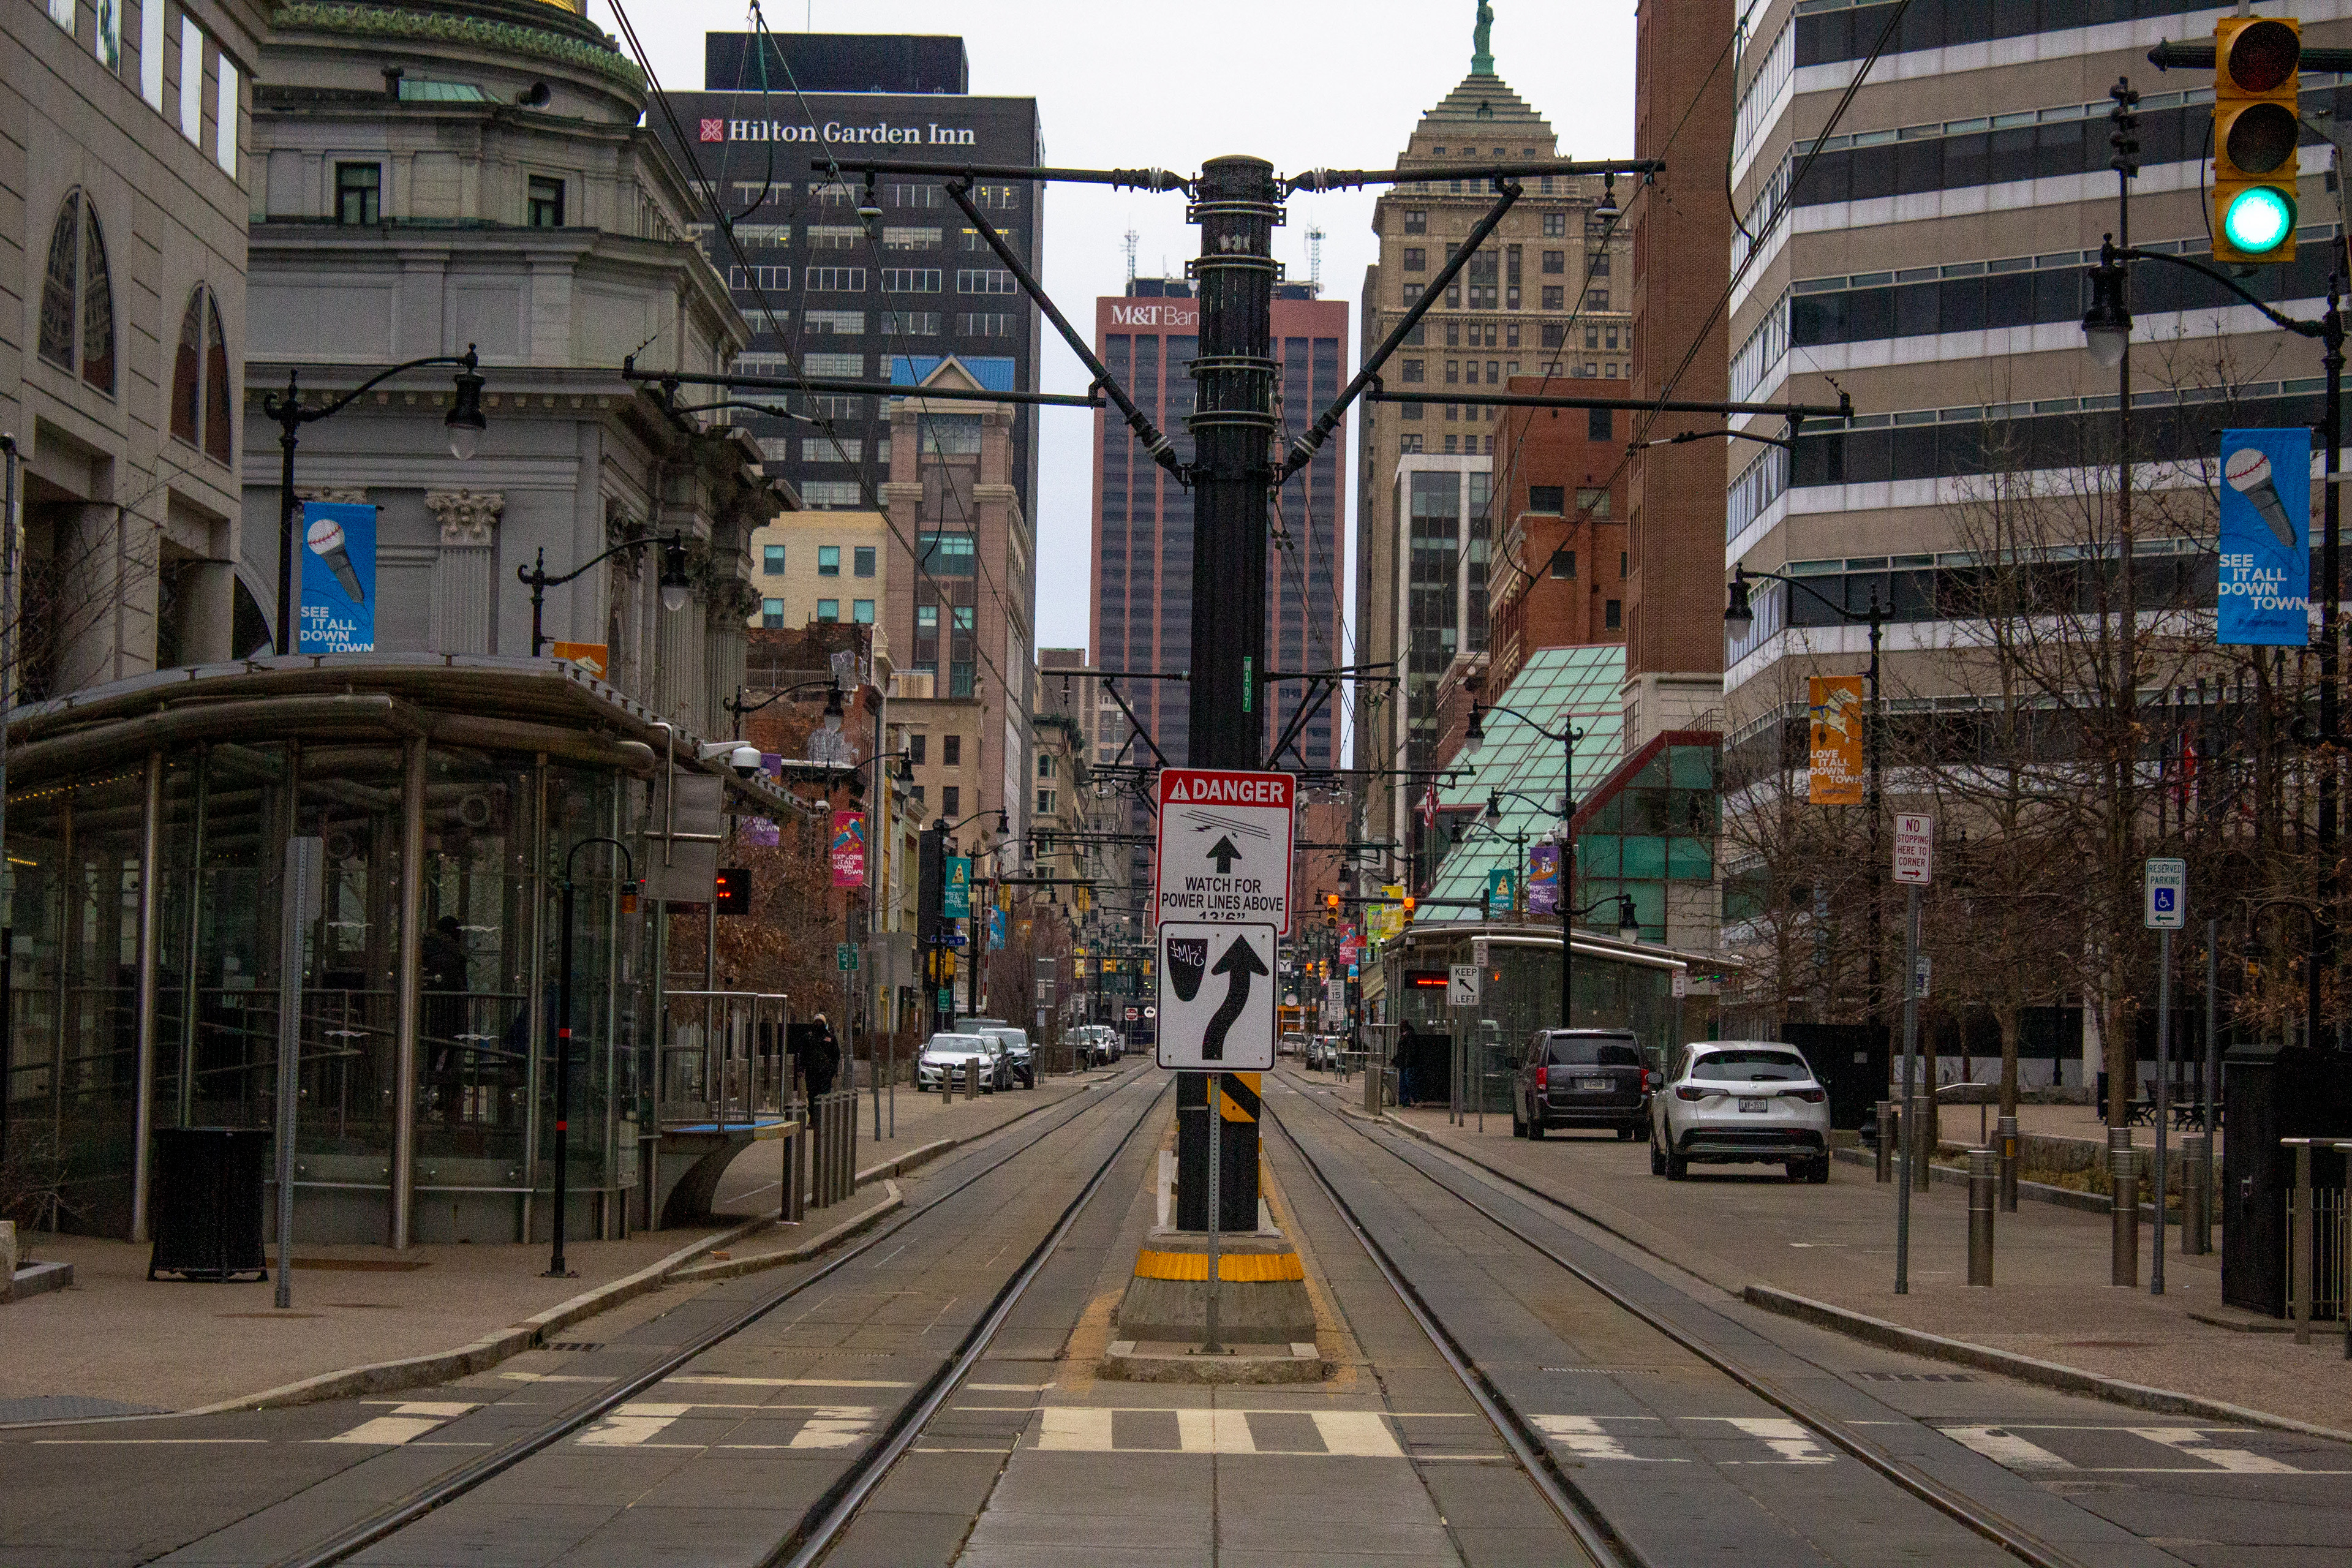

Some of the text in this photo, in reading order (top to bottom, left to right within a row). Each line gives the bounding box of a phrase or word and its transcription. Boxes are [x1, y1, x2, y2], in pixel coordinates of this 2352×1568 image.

[729, 120, 976, 145] Hilton Garden Inn
[1111, 305, 1199, 326] M&T Ban
[2219, 554, 2254, 568] SEE
[2233, 568, 2287, 581] IT ALL
[2218, 582, 2278, 596] DOWN
[2251, 597, 2309, 611] TOWN
[301, 606, 330, 617] SEE
[312, 619, 357, 630] IT ALL
[300, 630, 349, 642] DOWN
[326, 643, 374, 653] TOWN
[1810, 750, 1839, 758] LOVE
[1829, 758, 1850, 767] ALL
[1810, 767, 1845, 775] DOWN
[1828, 775, 1863, 785] TOWN
[1193, 778, 1284, 803] DANGER
[1906, 820, 1920, 832] NO
[1897, 834, 1929, 845] STOPPING
[1898, 845, 1927, 856] HERE TO
[1899, 857, 1925, 867] CORNER
[2148, 864, 2182, 874] RESERVED
[1185, 876, 1262, 894] WATCH FOR
[2150, 876, 2180, 885] PARKING
[1161, 892, 1283, 912] POWER LINES ABOVE
[1455, 995, 1476, 1003] LEFT
